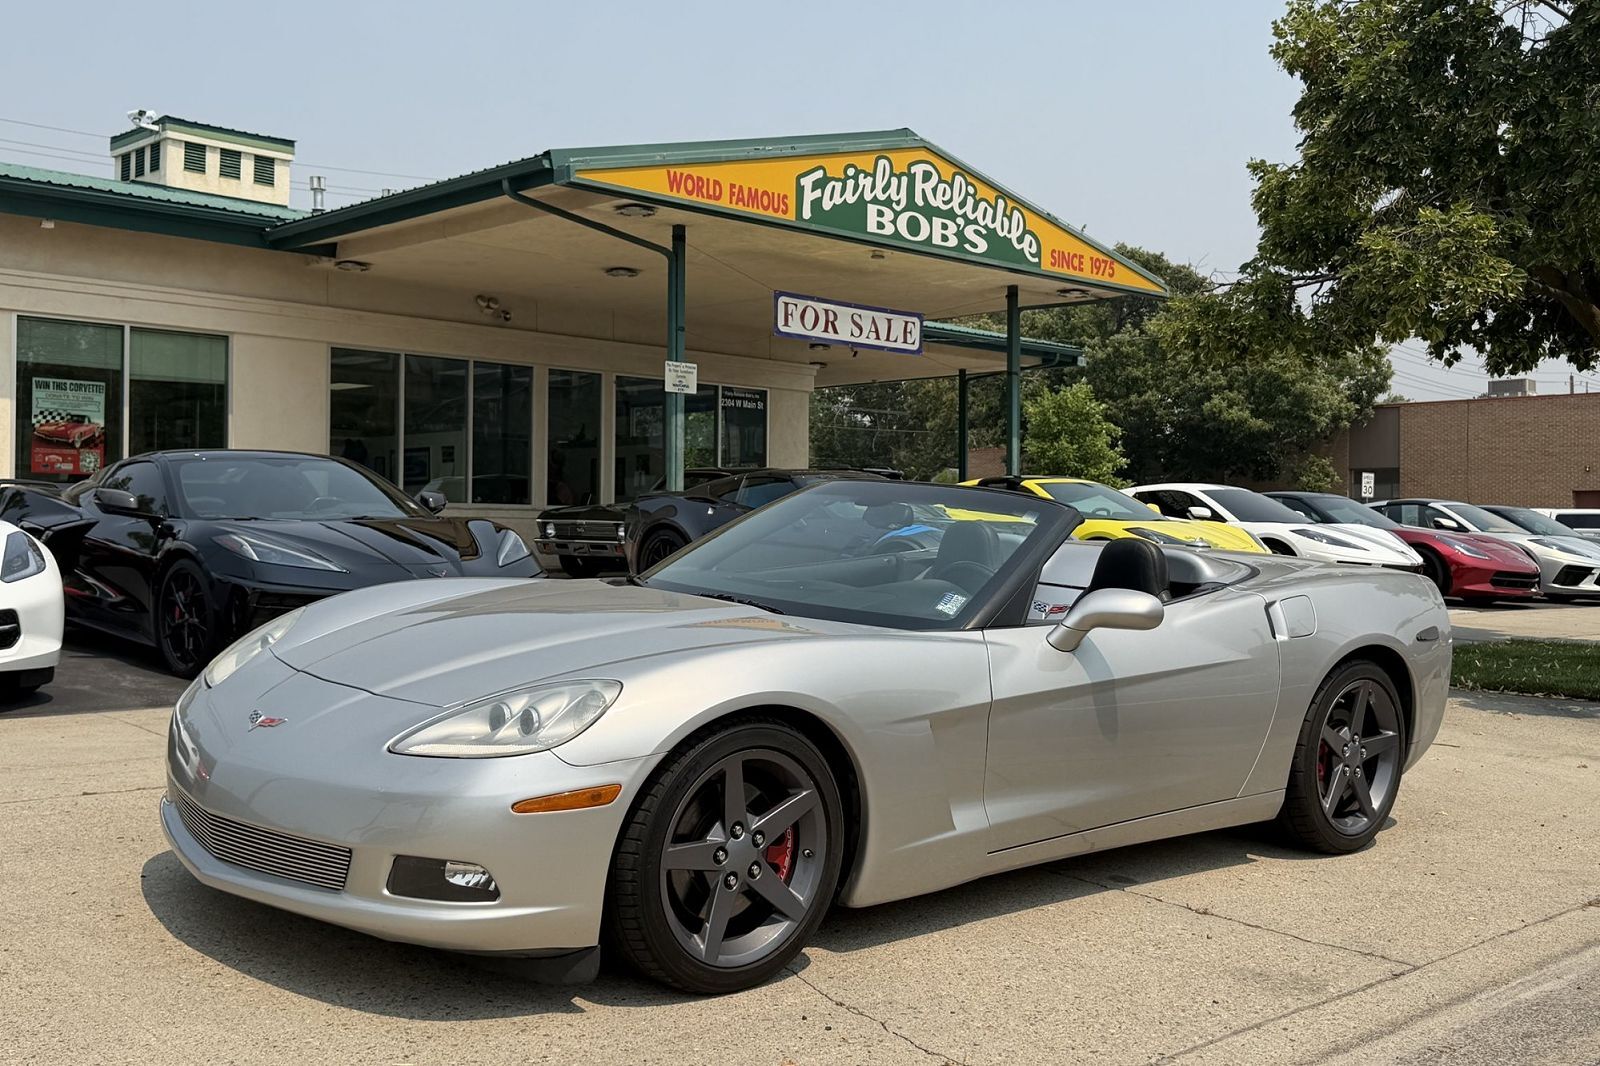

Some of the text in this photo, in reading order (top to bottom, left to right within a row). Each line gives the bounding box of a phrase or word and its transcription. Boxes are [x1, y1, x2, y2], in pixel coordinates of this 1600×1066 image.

[666, 169, 789, 216] WORLD FAMOUS
[799, 158, 1039, 263] Fairly Reliable
[866, 203, 989, 254] BOB'S
[1050, 248, 1115, 278] SINCE 1975
[782, 301, 917, 346] FOR SALE
[34, 379, 51, 391] WIN
[52, 380, 68, 392] THIS
[721, 398, 764, 410] 2304 W Main St
[1363, 485, 1373, 495] 30
